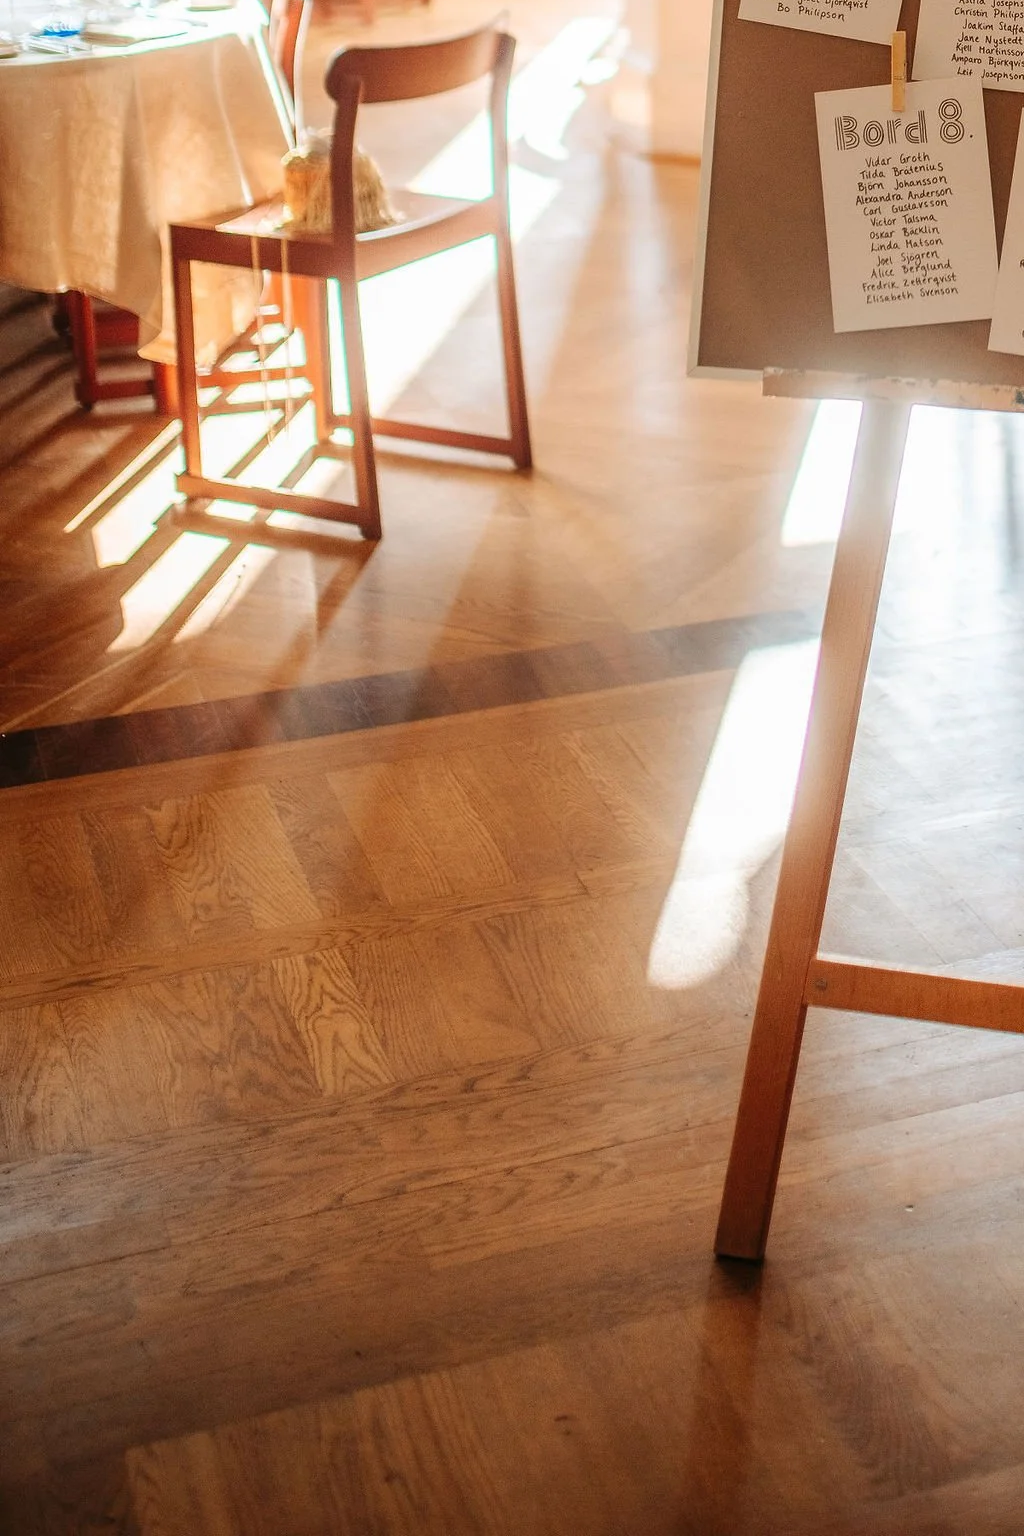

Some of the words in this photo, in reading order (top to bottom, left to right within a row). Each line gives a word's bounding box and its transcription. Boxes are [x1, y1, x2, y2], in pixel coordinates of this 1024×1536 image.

[777, 2, 790, 13] Bo
[798, 5, 845, 22] Philipson
[954, 7, 988, 18] Christin
[962, 18, 994, 31] Joakim
[957, 31, 980, 43] Jane
[985, 35, 1023, 50] Nystedt
[834, 109, 928, 151] Bord
[938, 98, 973, 144] 8.
[865, 155, 892, 168] Vidar
[857, 181, 885, 195] Björn
[894, 175, 948, 191] Johansson
[870, 217, 897, 227] Victor
[871, 243, 900, 253] Linda
[876, 255, 893, 267] Joel
[871, 268, 895, 279] Alice
